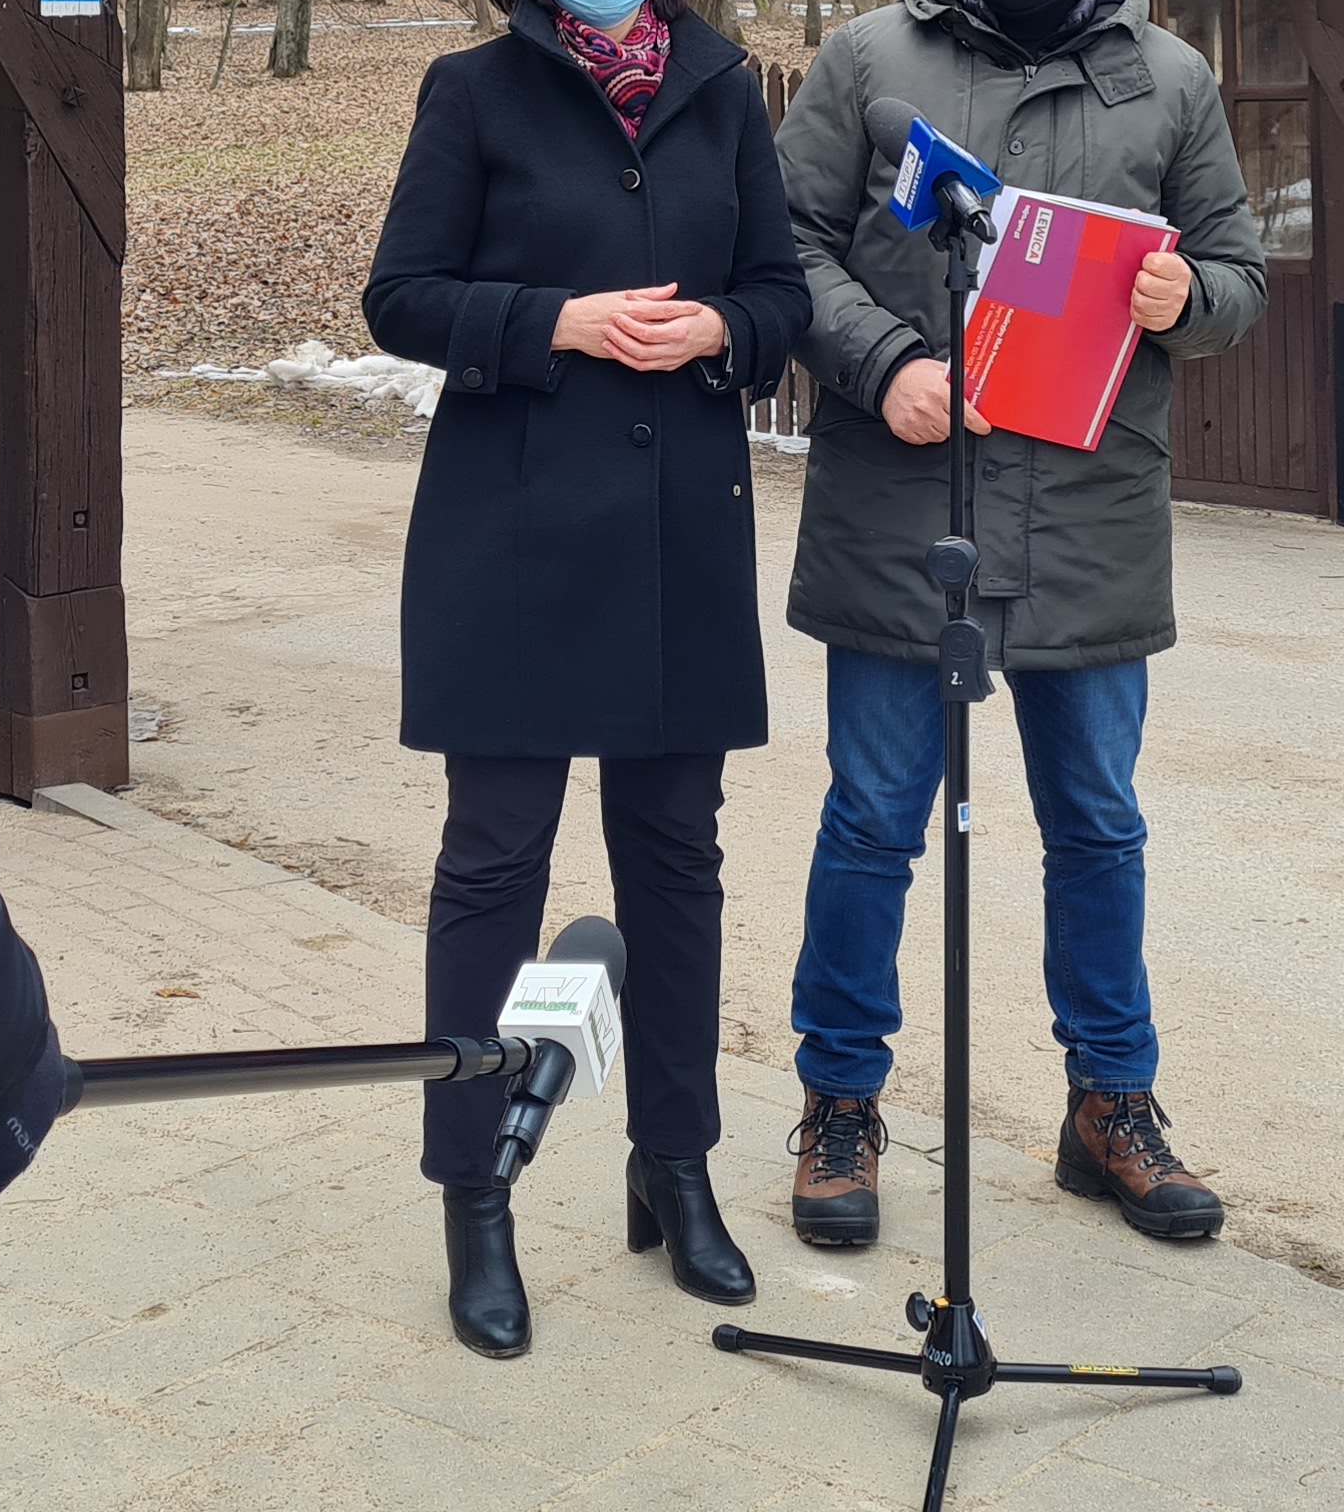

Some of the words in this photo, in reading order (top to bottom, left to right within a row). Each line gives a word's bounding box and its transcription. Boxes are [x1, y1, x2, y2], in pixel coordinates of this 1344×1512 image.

[1029, 211, 1050, 260] LEWICA
[950, 671, 964, 685] 2.
[520, 977, 587, 1007] TV
